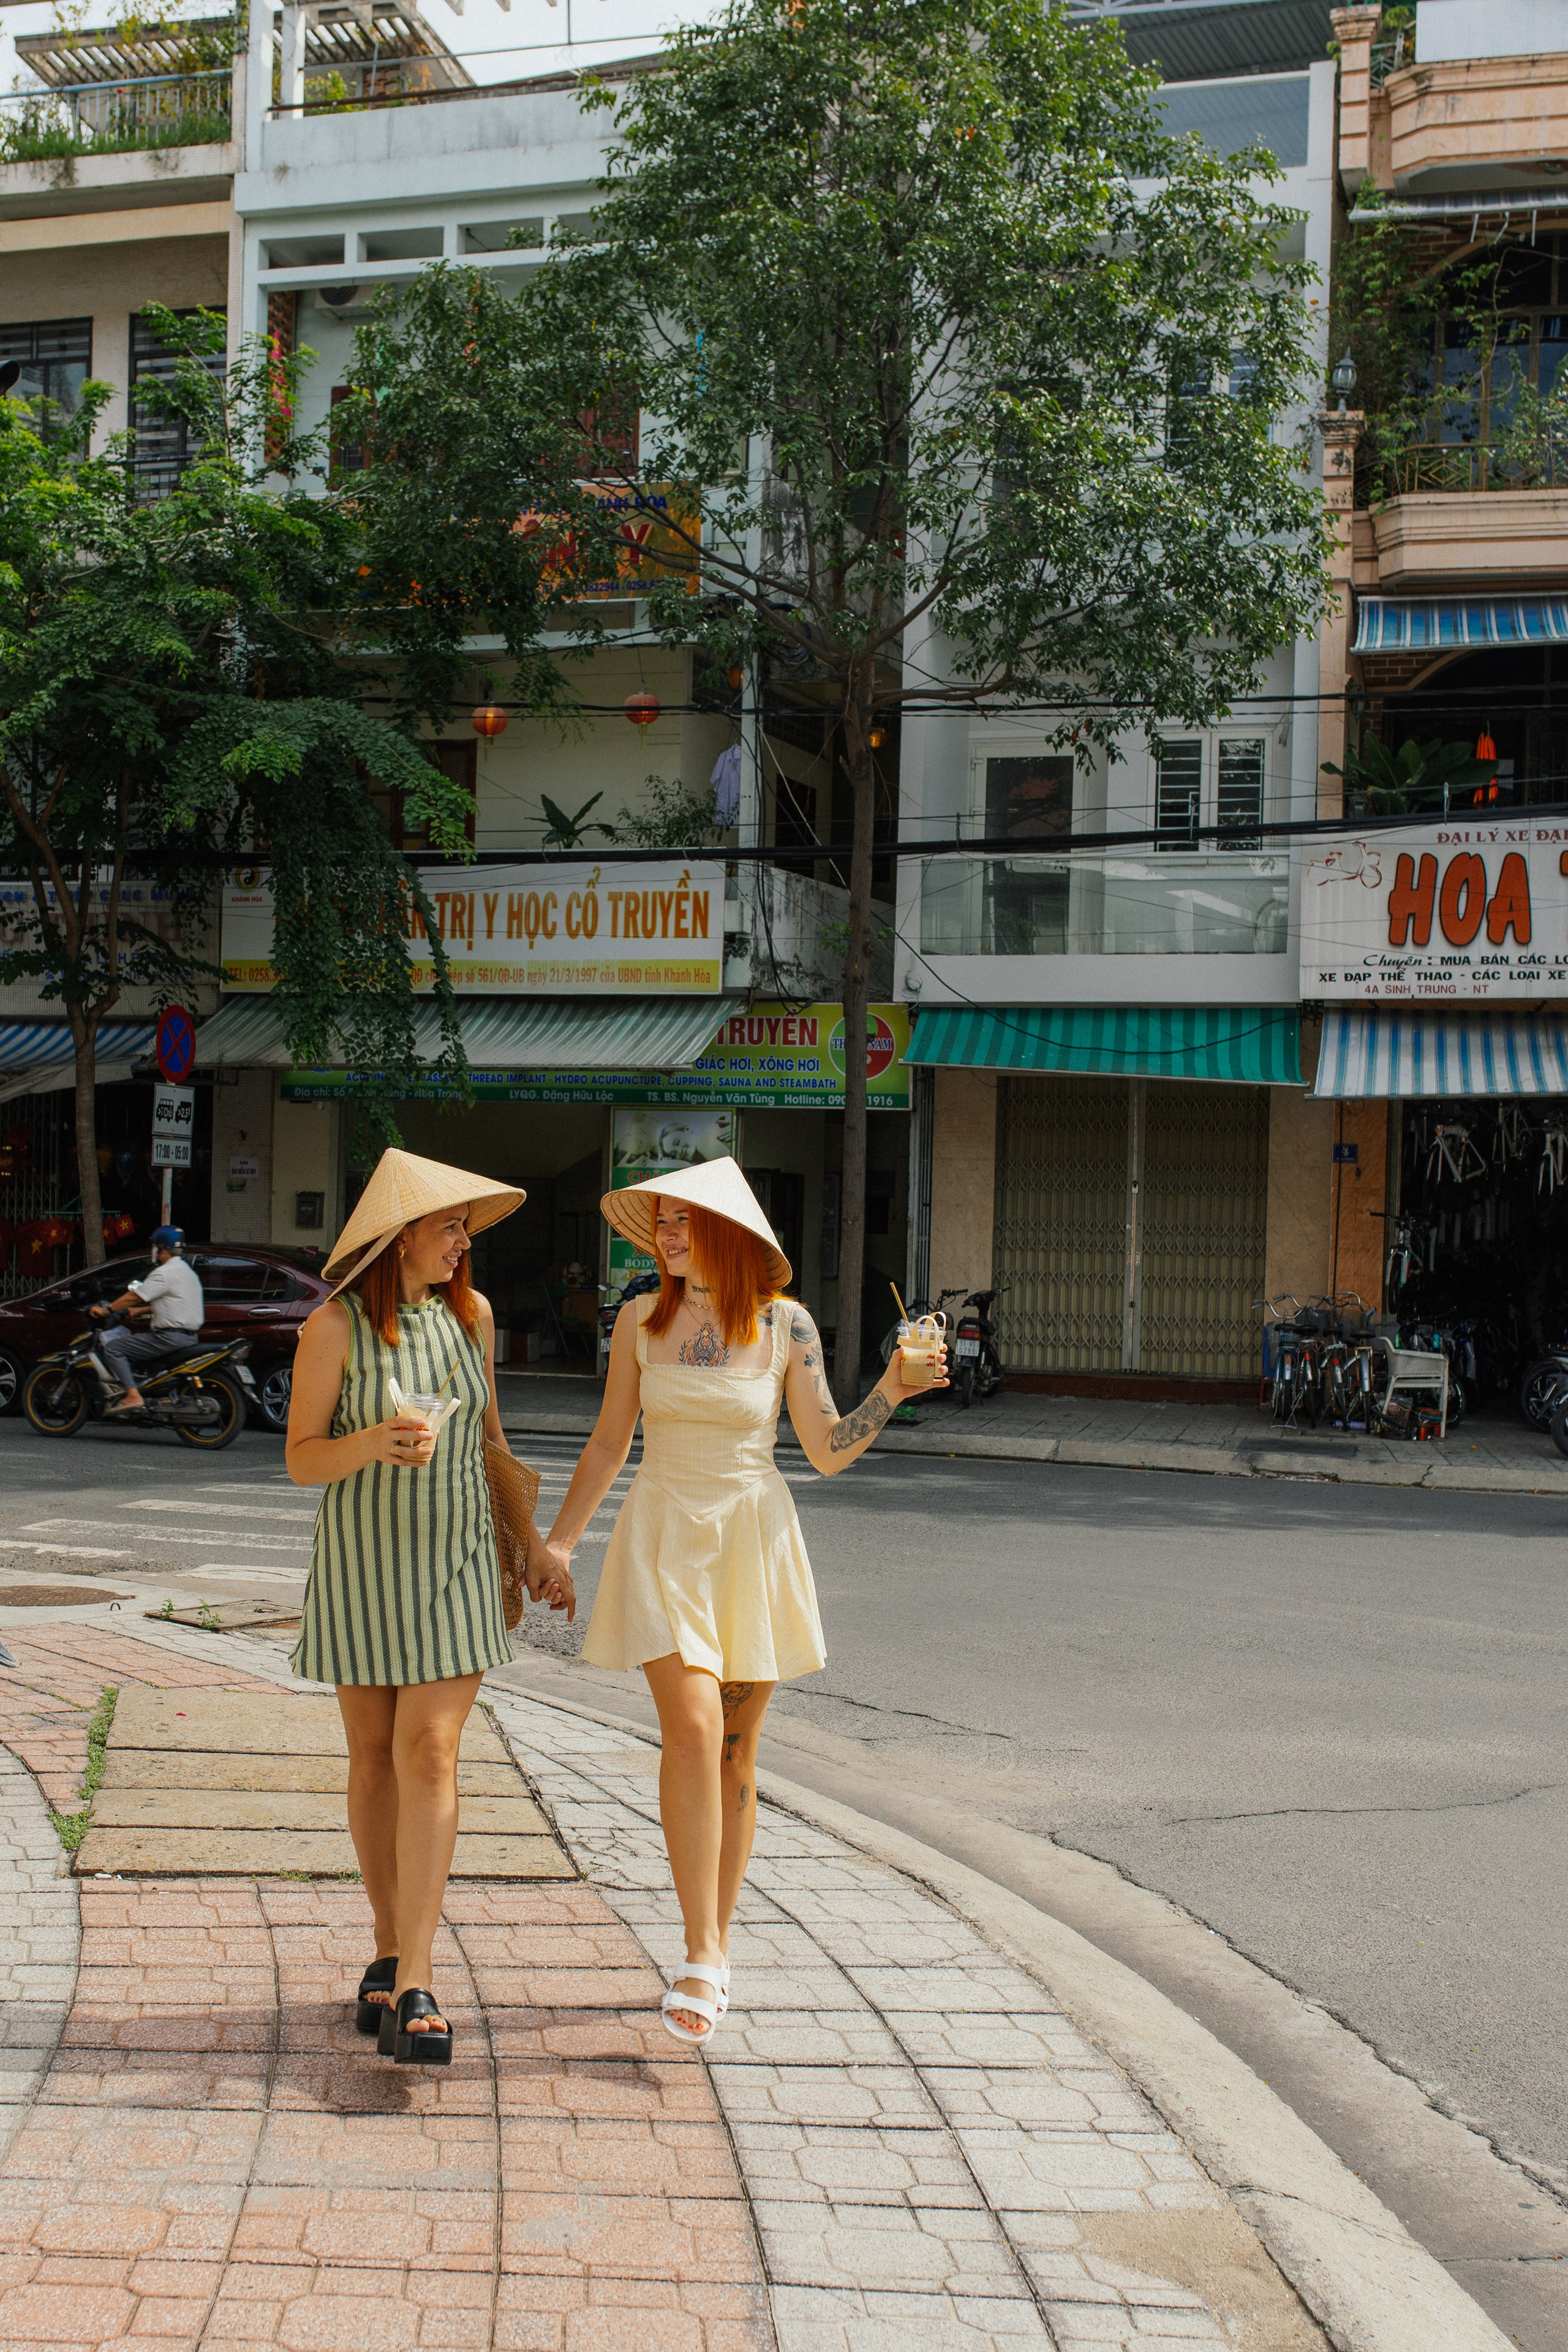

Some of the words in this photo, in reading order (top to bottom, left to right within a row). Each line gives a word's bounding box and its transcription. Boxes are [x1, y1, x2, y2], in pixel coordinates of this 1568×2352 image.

[1437, 832, 1469, 846] ĐẠI
[1477, 827, 1501, 843] LÝ
[1506, 830, 1529, 842] XE
[1388, 852, 1532, 947] HOA
[435, 892, 473, 951] TRỊ
[483, 892, 499, 940] Y
[507, 891, 557, 950] HỌC
[565, 866, 602, 940] CỔ
[608, 869, 710, 939] TRUYỀN
[1363, 954, 1423, 970] Chuyên
[1441, 956, 1471, 965] MUA
[1481, 953, 1509, 965] BÁN
[1518, 952, 1547, 965] CÁC
[466, 966, 477, 982] số
[527, 968, 547, 986] ngày
[551, 967, 597, 983] 21/3/1997
[600, 965, 616, 983] của
[618, 967, 641, 983] UBND
[645, 965, 662, 984] tỉnh
[664, 966, 691, 984] Khánh
[693, 967, 710, 984] Hòa
[1319, 973, 1337, 982] XE
[1344, 973, 1372, 984] ĐẠP
[1415, 972, 1452, 981] THAO
[1472, 968, 1501, 981] CÁC
[1509, 971, 1540, 983] LOẠI
[1548, 970, 1566, 980] XE
[1365, 986, 1379, 995] 4A
[1385, 985, 1411, 995] SINH
[1417, 985, 1457, 994] TRUNG
[1473, 985, 1489, 994] NT
[696, 1057, 726, 1072] GIÁC
[729, 1056, 755, 1074] HƠI,
[758, 1056, 794, 1072] XÔNG
[798, 1057, 820, 1072] HƠI
[468, 1073, 503, 1084] THREAD
[507, 1074, 546, 1084] IMPLANT
[554, 1074, 589, 1085] HYDRO
[590, 1075, 665, 1088] ACUPUNCTURE,
[668, 1076, 715, 1089] CUPPING,
[718, 1077, 752, 1088] SAUNA
[755, 1077, 776, 1088] AND
[779, 1078, 837, 1089] STEAMBATH
[294, 1087, 312, 1098] Địa
[509, 1090, 540, 1101] LYQG.
[543, 1089, 570, 1102] Đặng
[573, 1090, 594, 1101] Hữu
[596, 1090, 614, 1102] Lộc
[647, 1092, 660, 1101] TS.
[664, 1093, 679, 1102] BS.
[683, 1092, 723, 1106] Nguyễn
[725, 1093, 747, 1103] Văn
[749, 1093, 775, 1106] Tùng
[785, 1095, 825, 1104] Hotline:
[156, 1144, 170, 1159] 17:00
